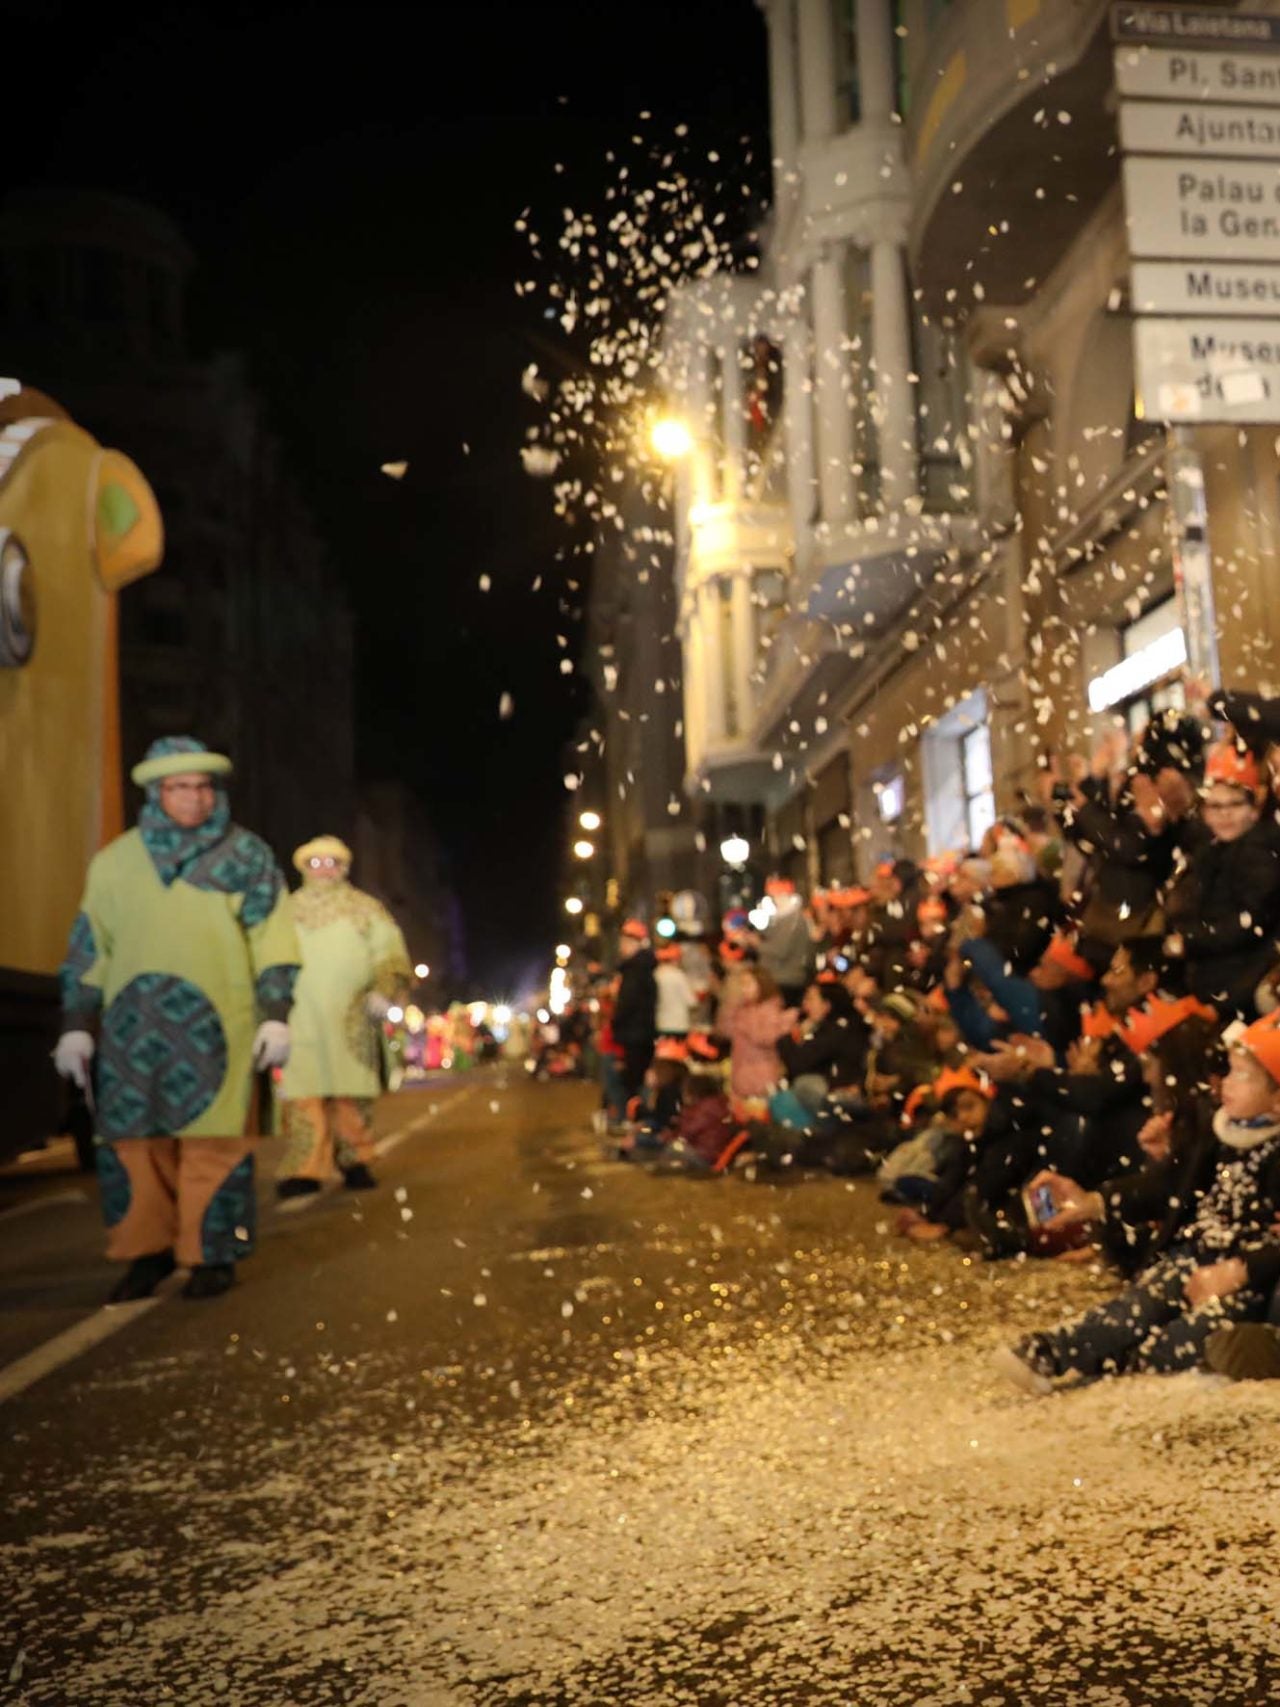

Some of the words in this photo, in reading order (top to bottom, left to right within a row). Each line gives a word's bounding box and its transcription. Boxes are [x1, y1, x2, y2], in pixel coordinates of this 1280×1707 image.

[1169, 57, 1210, 85] Pl.
[1179, 173, 1265, 203] Palau
[1181, 210, 1208, 236] la
